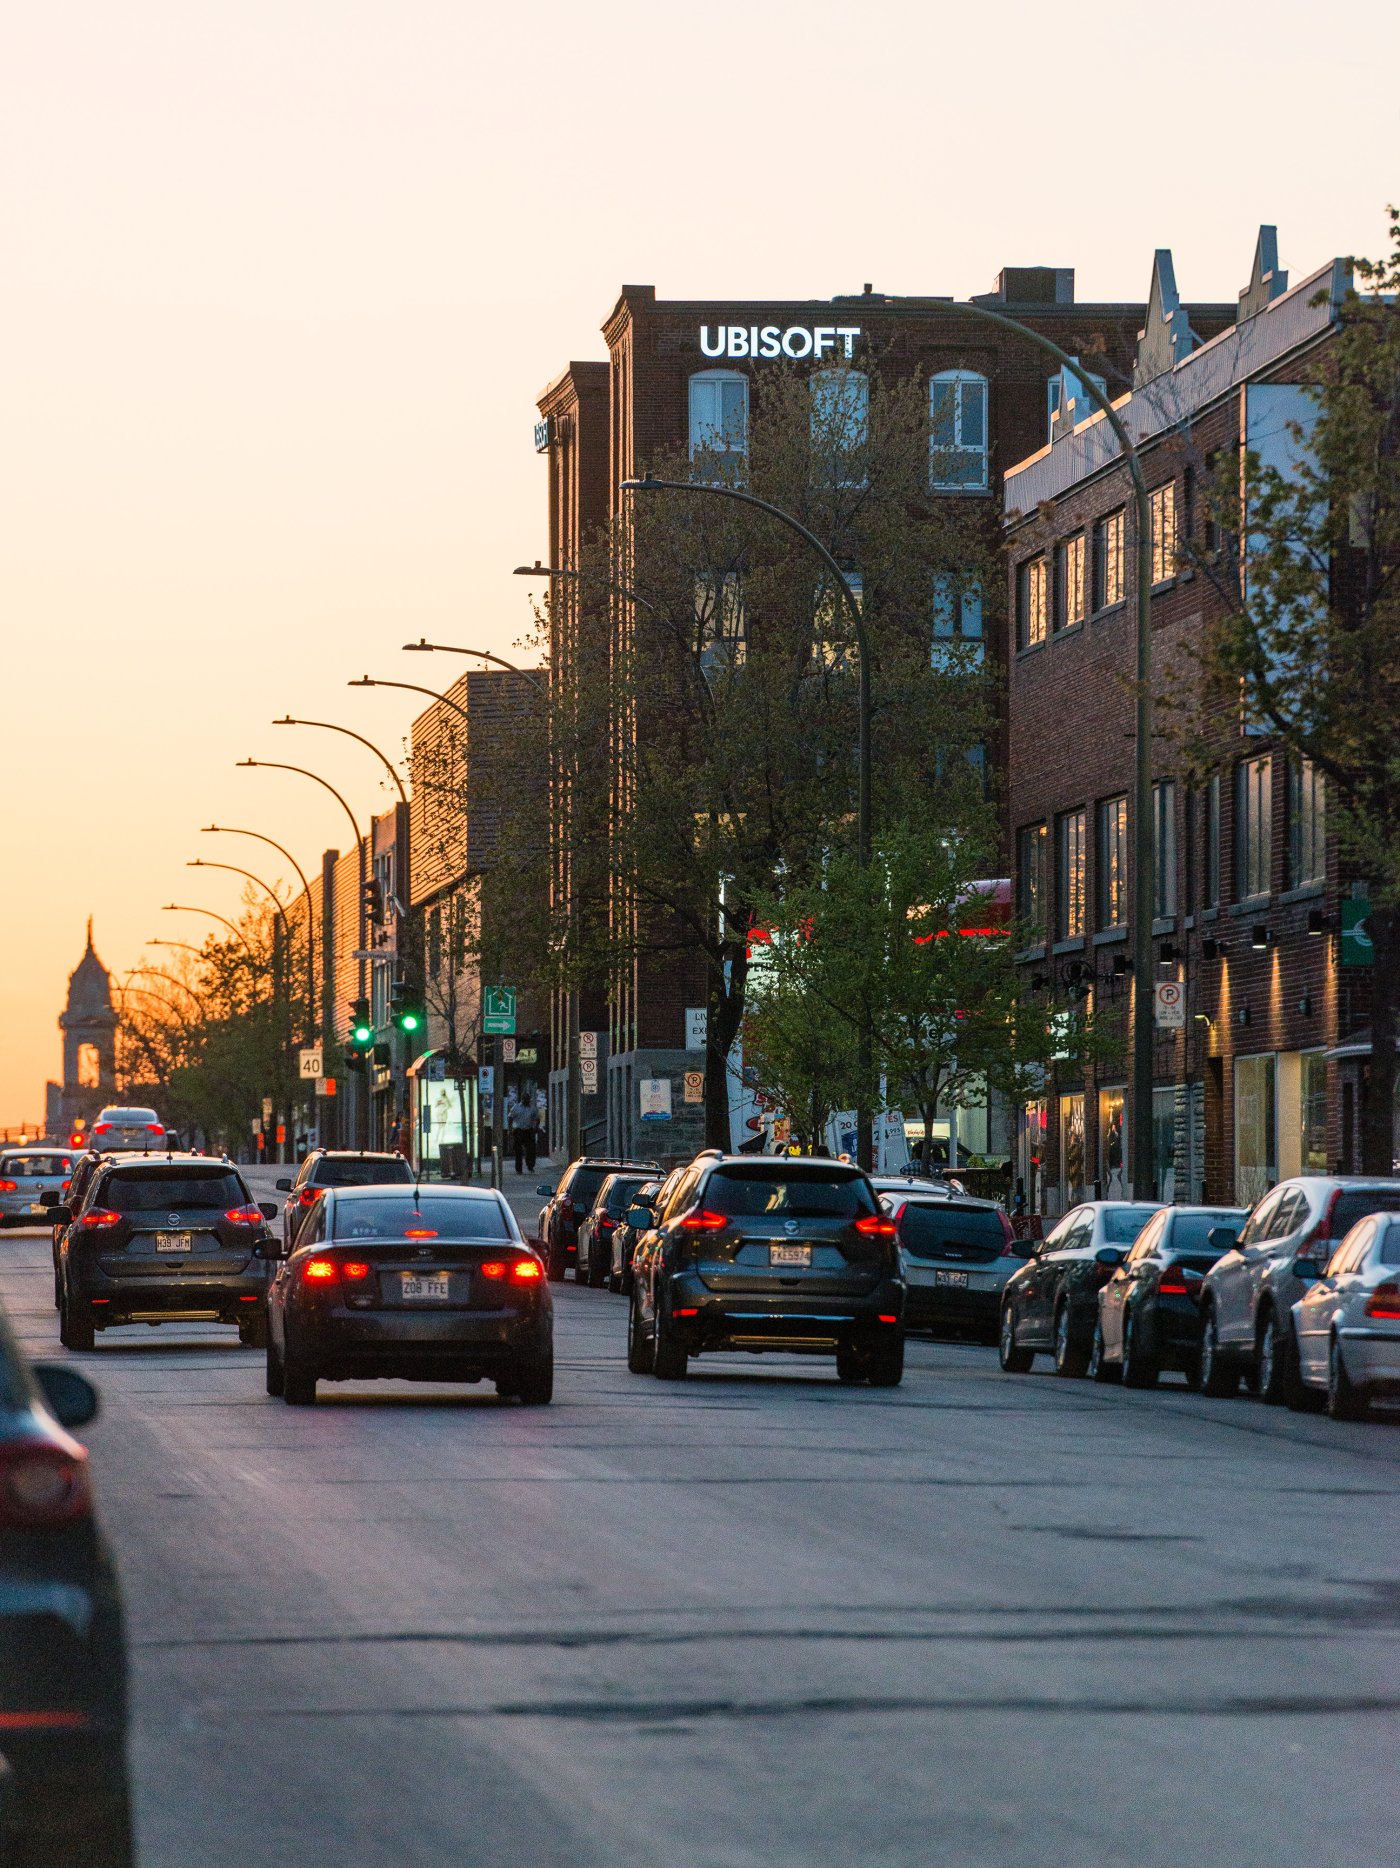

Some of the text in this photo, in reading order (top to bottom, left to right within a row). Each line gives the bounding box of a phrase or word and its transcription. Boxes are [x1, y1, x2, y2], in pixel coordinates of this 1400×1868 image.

[700, 326, 861, 358] UBISOFT
[303, 1059, 320, 1073] 40
[157, 1238, 171, 1248] H39
[771, 1250, 811, 1261] FKE5974
[403, 1281, 447, 1294] Z08 FFE
